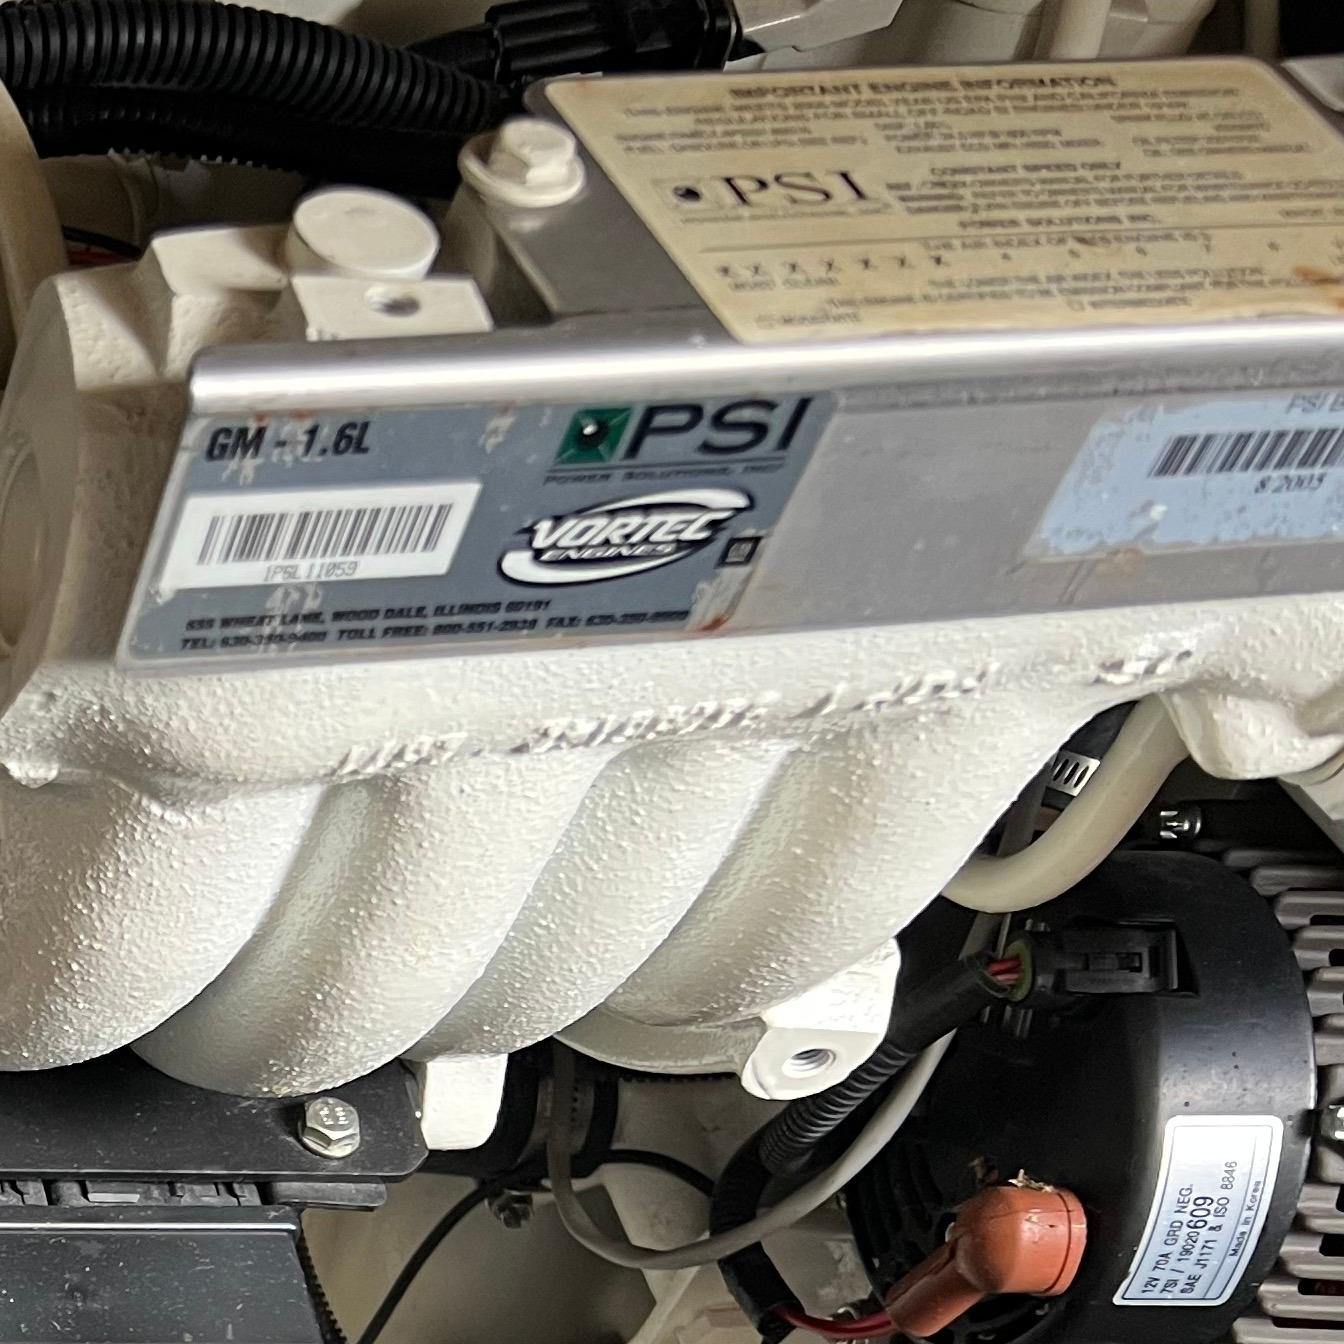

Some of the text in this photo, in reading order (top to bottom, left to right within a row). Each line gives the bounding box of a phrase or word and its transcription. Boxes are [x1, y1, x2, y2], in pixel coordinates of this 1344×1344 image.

[205, 420, 372, 462] GM 1.6L
[619, 397, 815, 460] PSI
[531, 508, 738, 549] VORTEC
[539, 543, 677, 562] ENGINES
[1141, 1183, 1193, 1294] 12V 70A GRD NEG.
[1180, 1161, 1237, 1294] SAE J1171 & ISO 8846
[1229, 1180, 1262, 1257] Made in Korea
